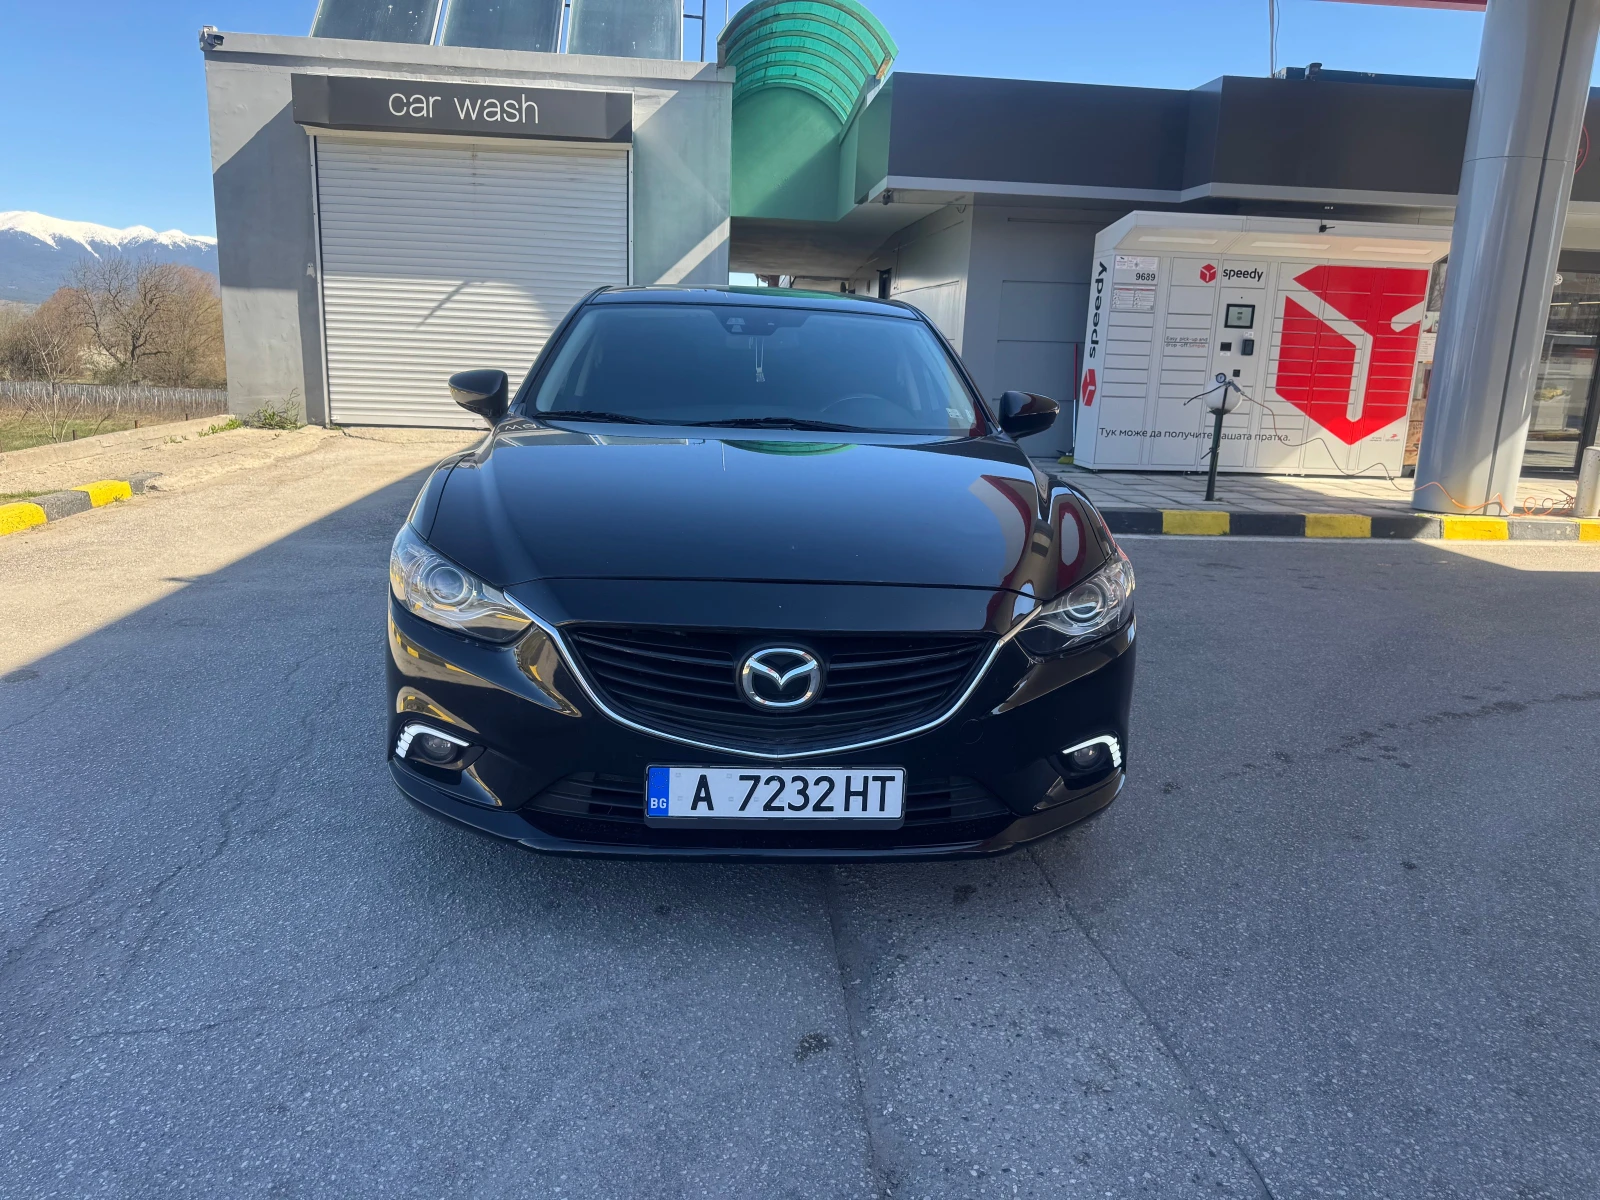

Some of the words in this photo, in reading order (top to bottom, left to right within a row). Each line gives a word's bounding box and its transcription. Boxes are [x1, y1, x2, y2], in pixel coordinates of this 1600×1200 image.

[388, 92, 441, 118] car
[454, 94, 538, 124] wash
[1222, 268, 1264, 282] speedy
[1090, 261, 1108, 358] speedy
[1099, 428, 1117, 438] Тук
[1164, 430, 1212, 440] получите
[1254, 434, 1291, 442] пратка.
[650, 798, 667, 809] BG
[690, 774, 714, 810] A
